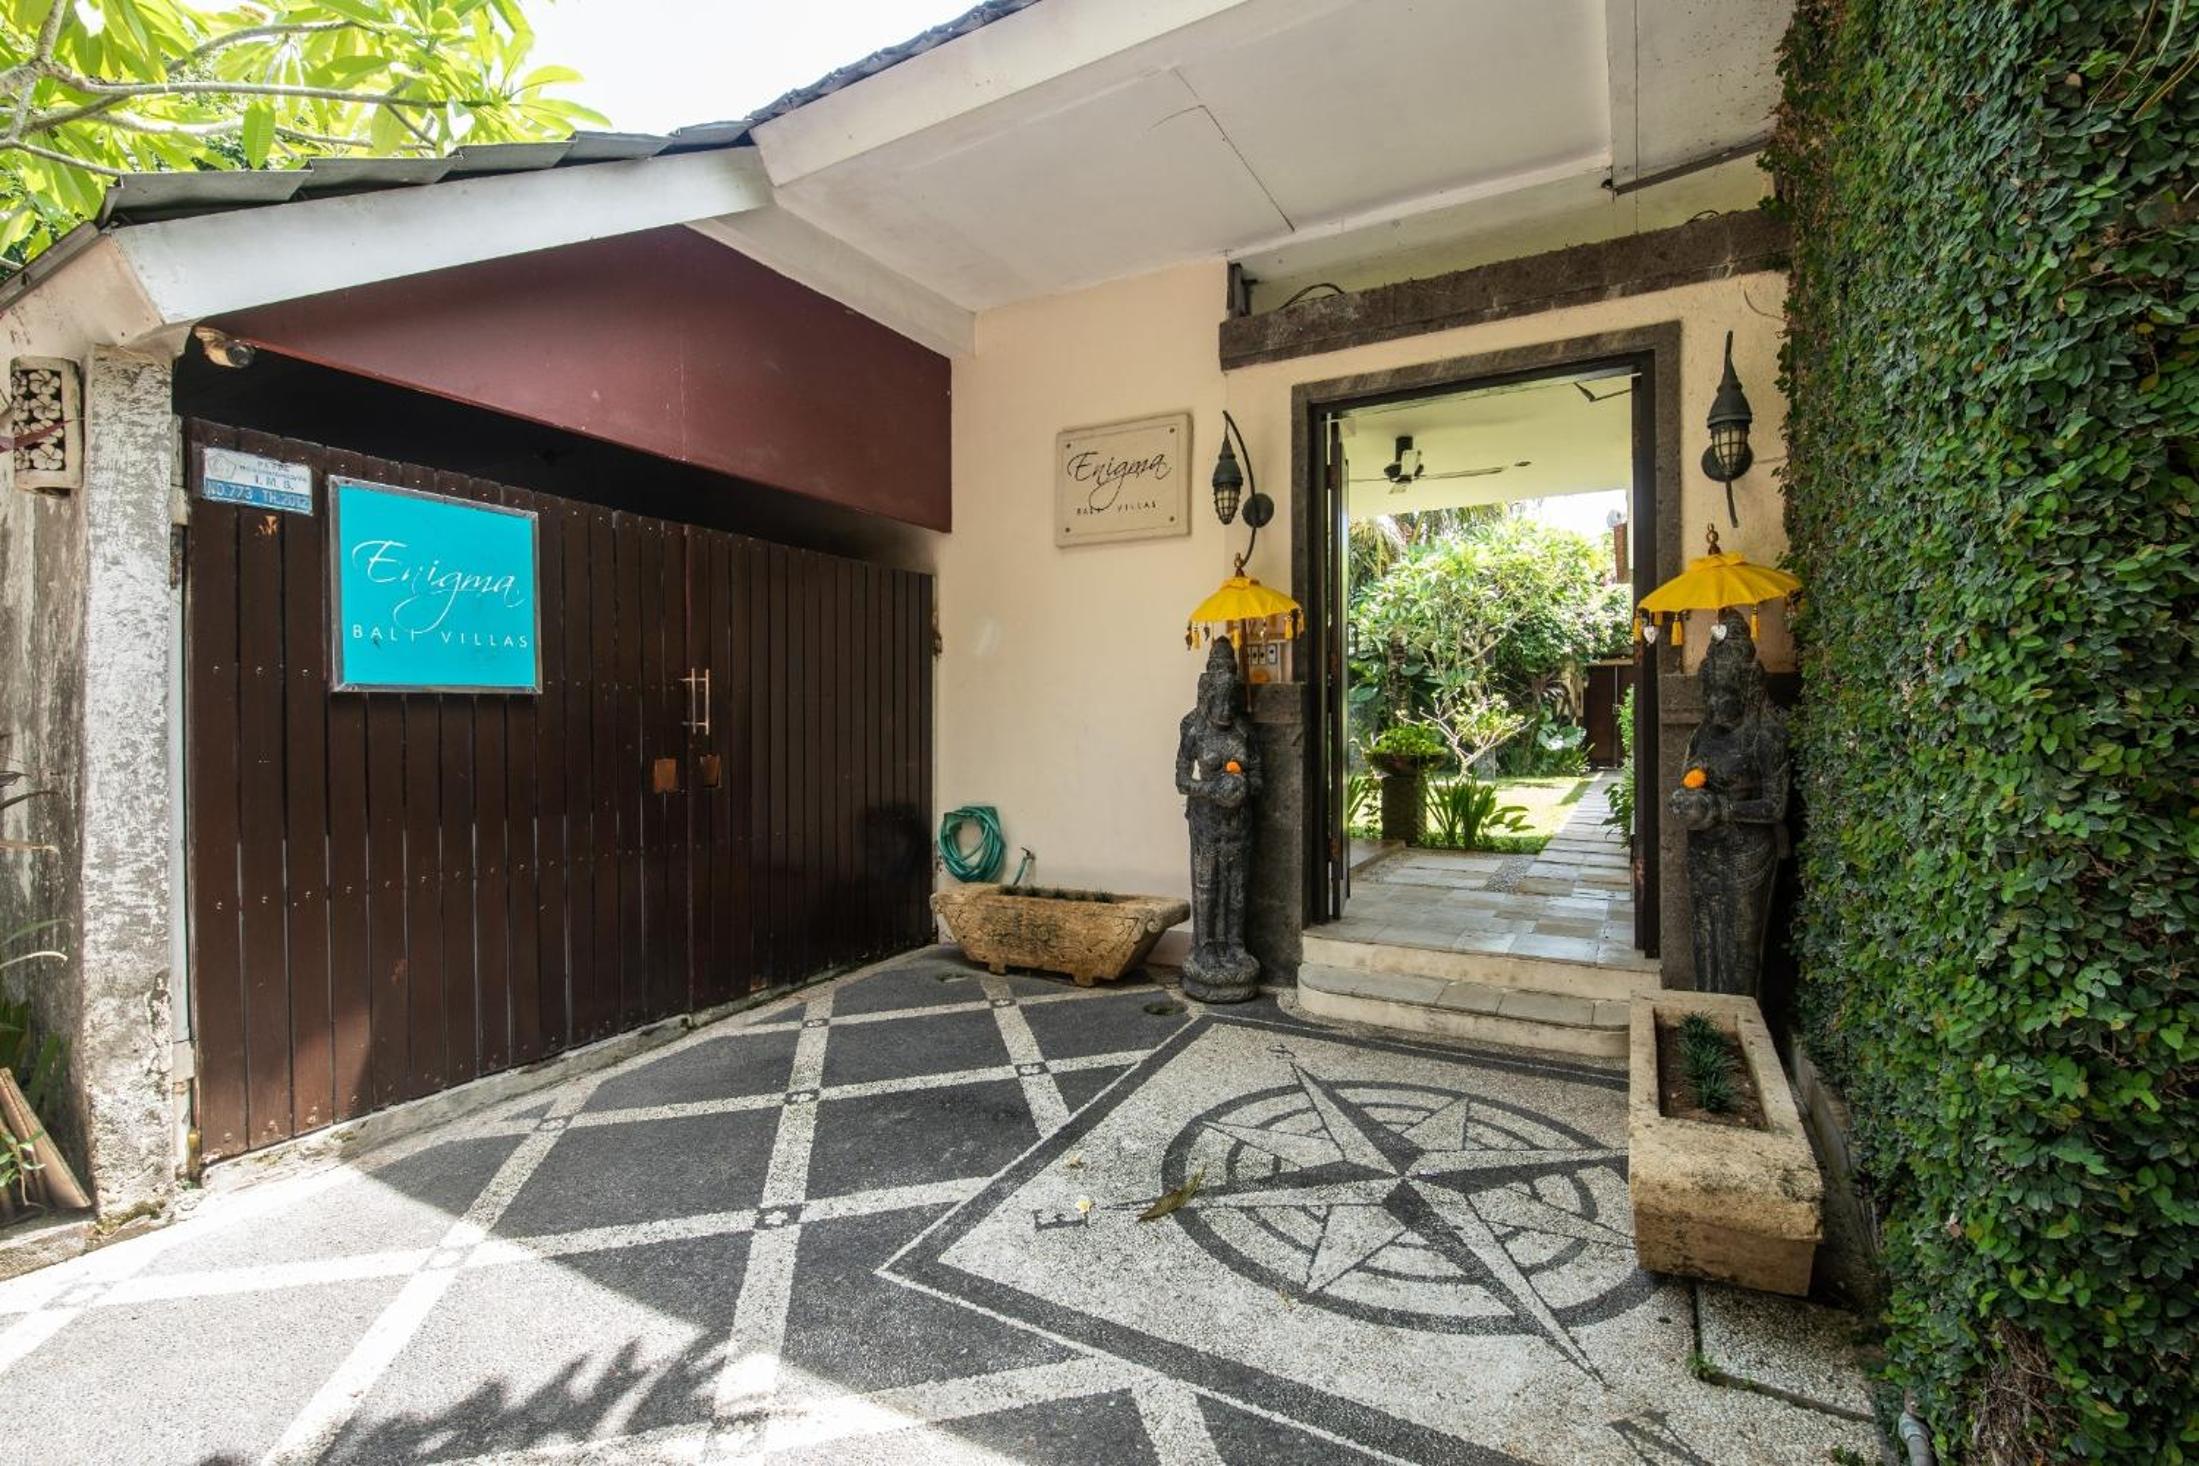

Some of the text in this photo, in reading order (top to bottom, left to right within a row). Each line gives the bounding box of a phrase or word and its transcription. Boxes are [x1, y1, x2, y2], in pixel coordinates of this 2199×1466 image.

[1067, 451, 1172, 511] Enigma
[352, 540, 526, 634] Enigma
[352, 624, 528, 648] BALI VILLAS
